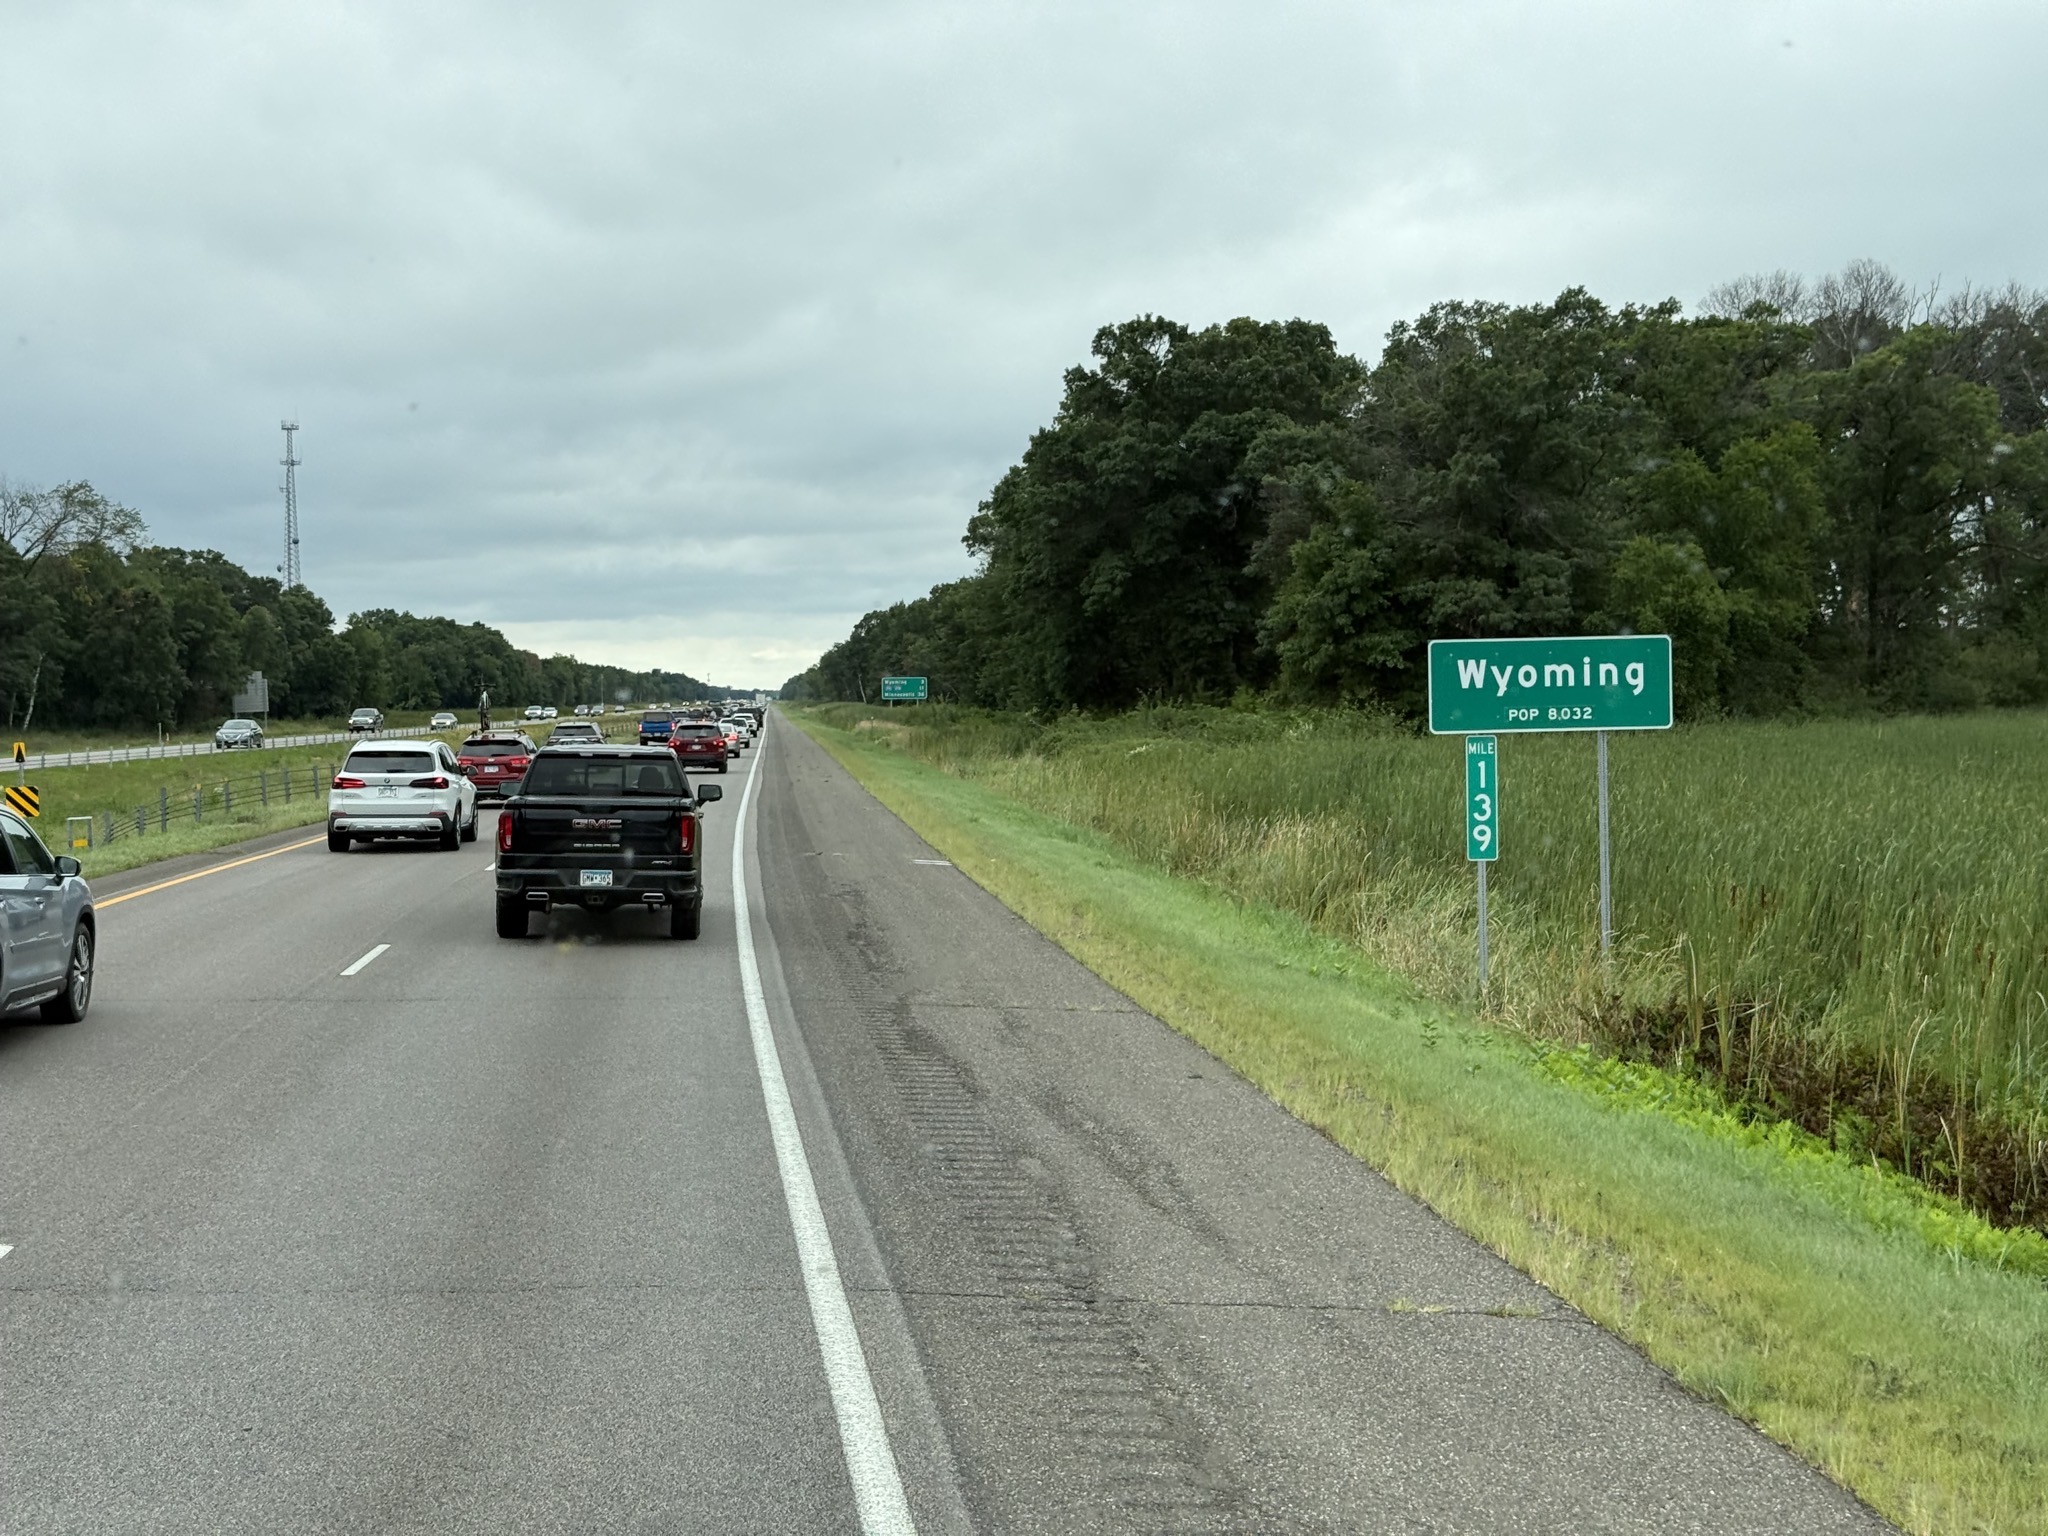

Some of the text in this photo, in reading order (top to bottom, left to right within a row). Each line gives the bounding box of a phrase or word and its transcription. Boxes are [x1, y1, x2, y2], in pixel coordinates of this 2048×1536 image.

[1457, 656, 1644, 697] Wyoming
[1508, 707, 1593, 721] POP 8,032
[1468, 742, 1494, 755] MILE
[1472, 761, 1492, 852] 139
[572, 819, 622, 829] GMC
